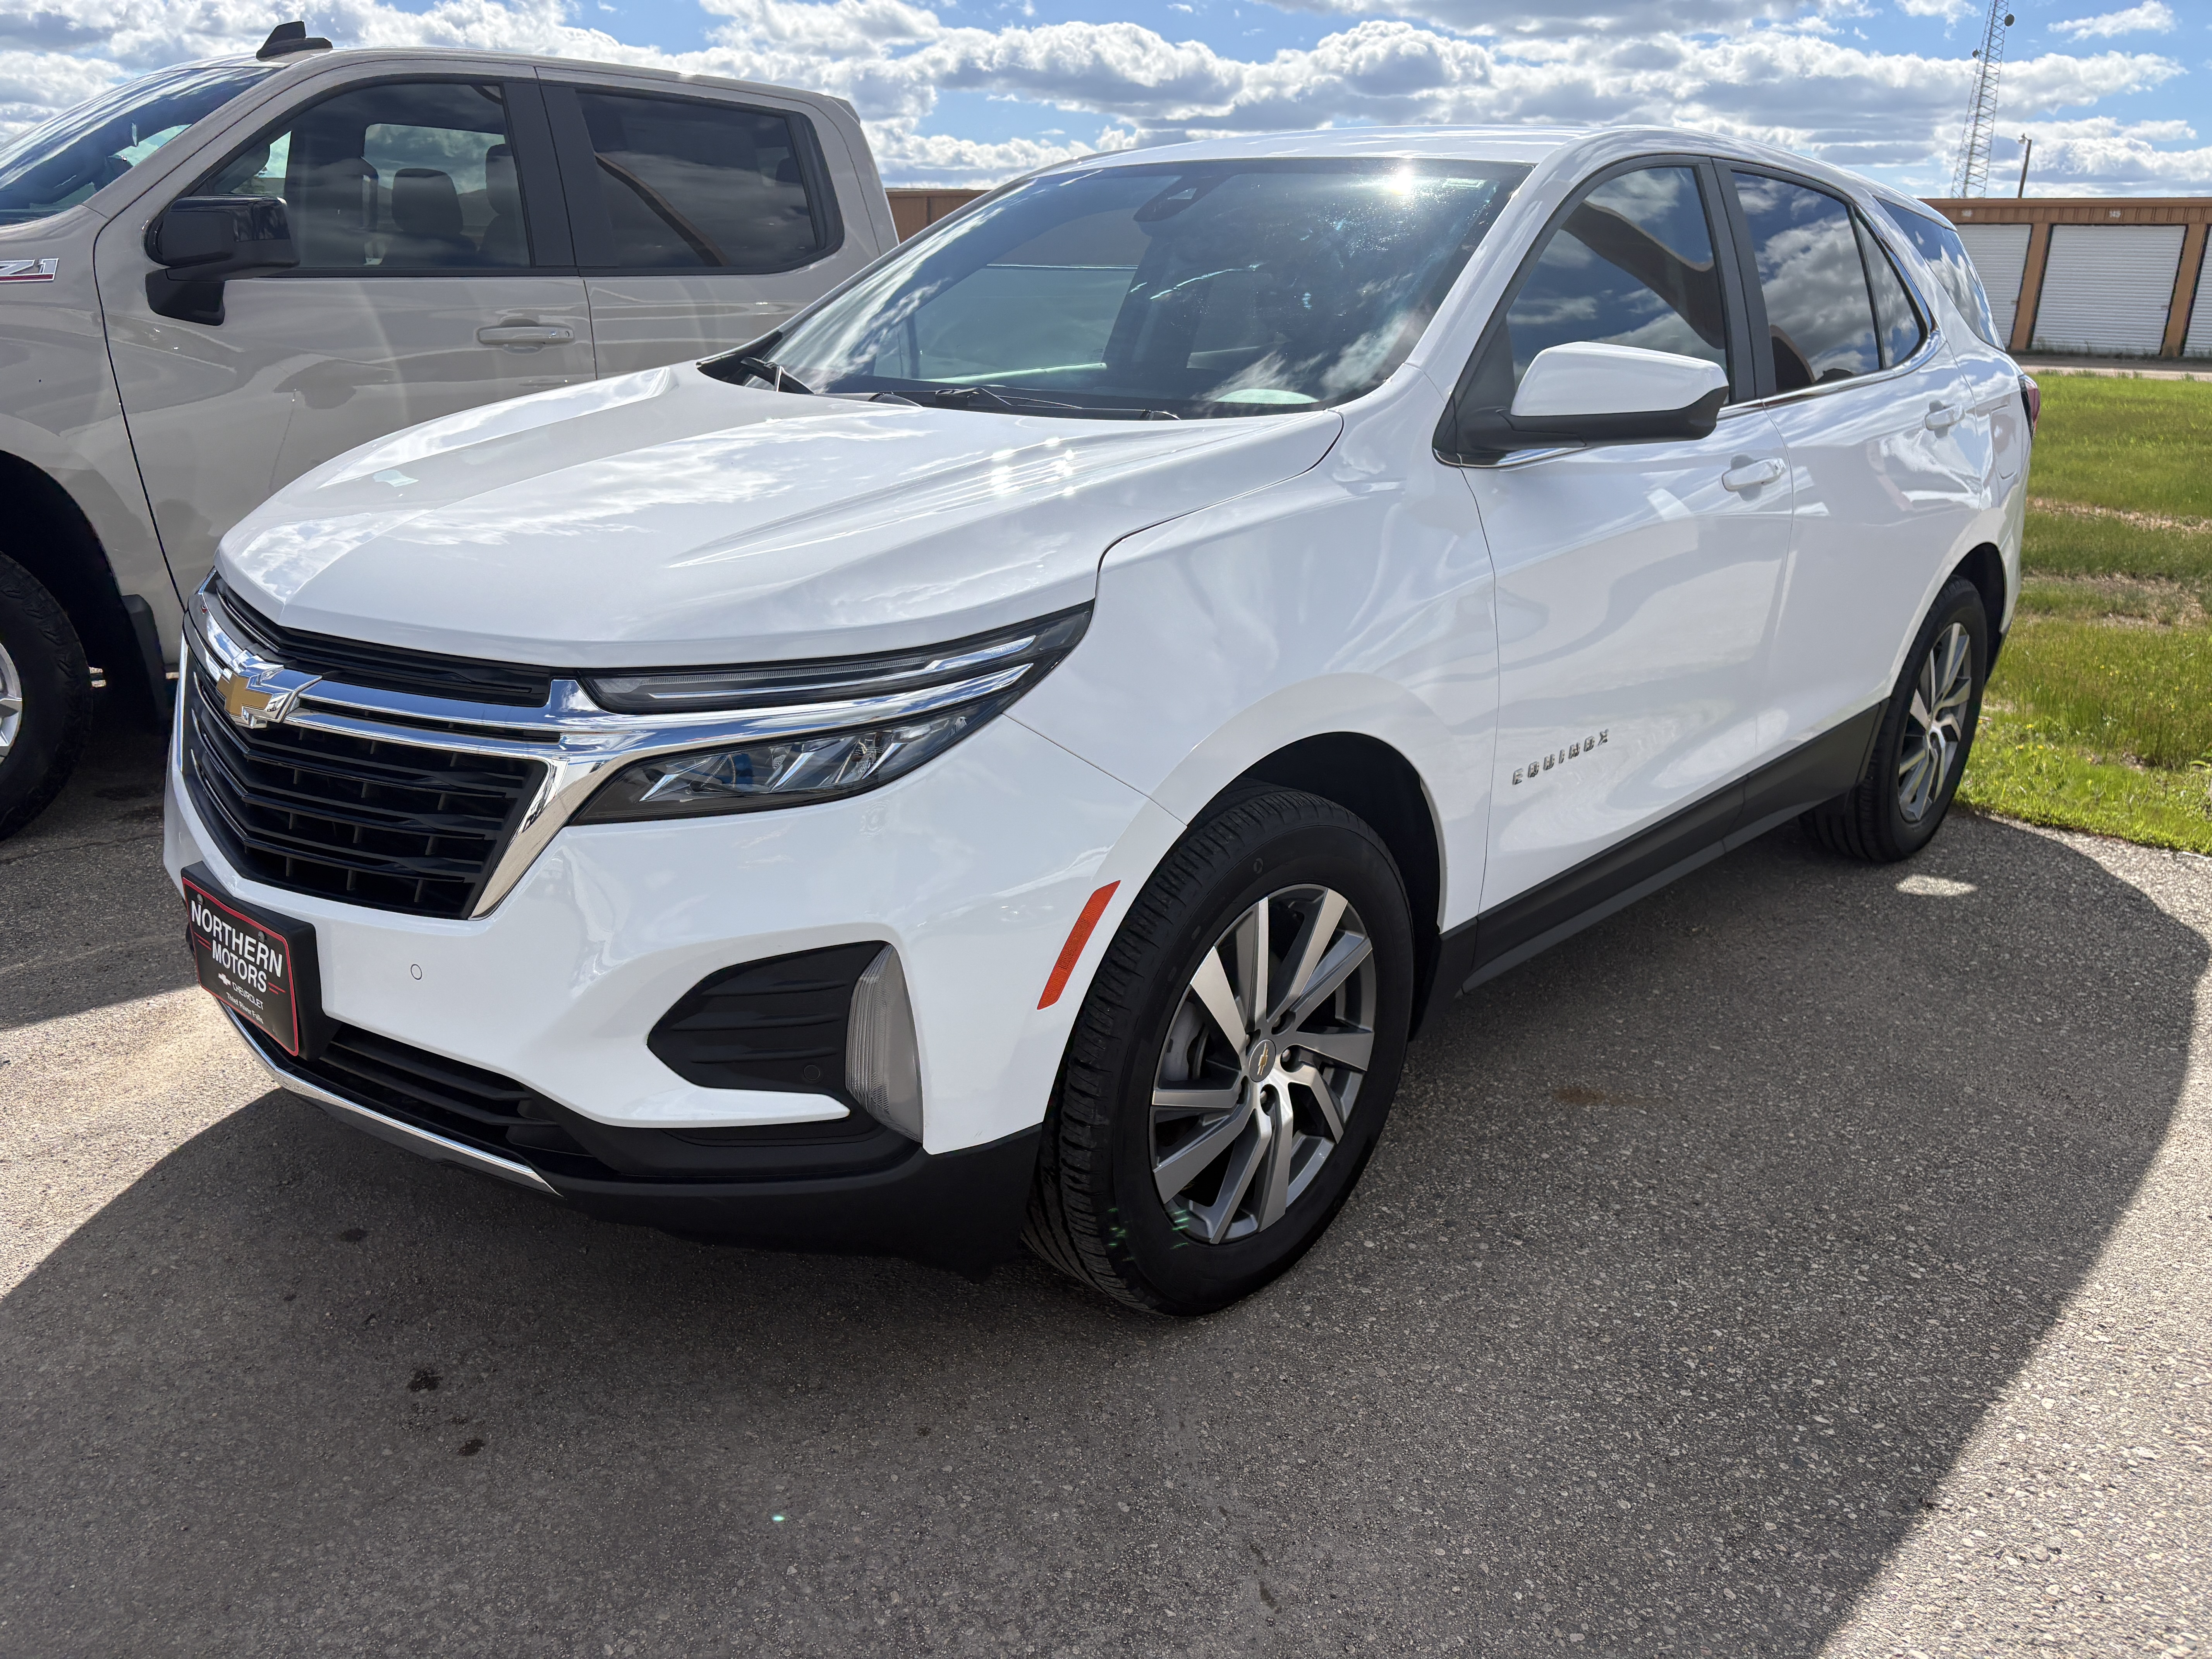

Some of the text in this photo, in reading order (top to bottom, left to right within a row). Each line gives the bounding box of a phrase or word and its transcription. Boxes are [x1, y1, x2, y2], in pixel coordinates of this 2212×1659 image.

[1512, 728, 1609, 785] EQUINOX
[191, 900, 282, 978] NORTHERN
[213, 939, 267, 993] MOTORS
[232, 982, 263, 1010] CHEVROLET
